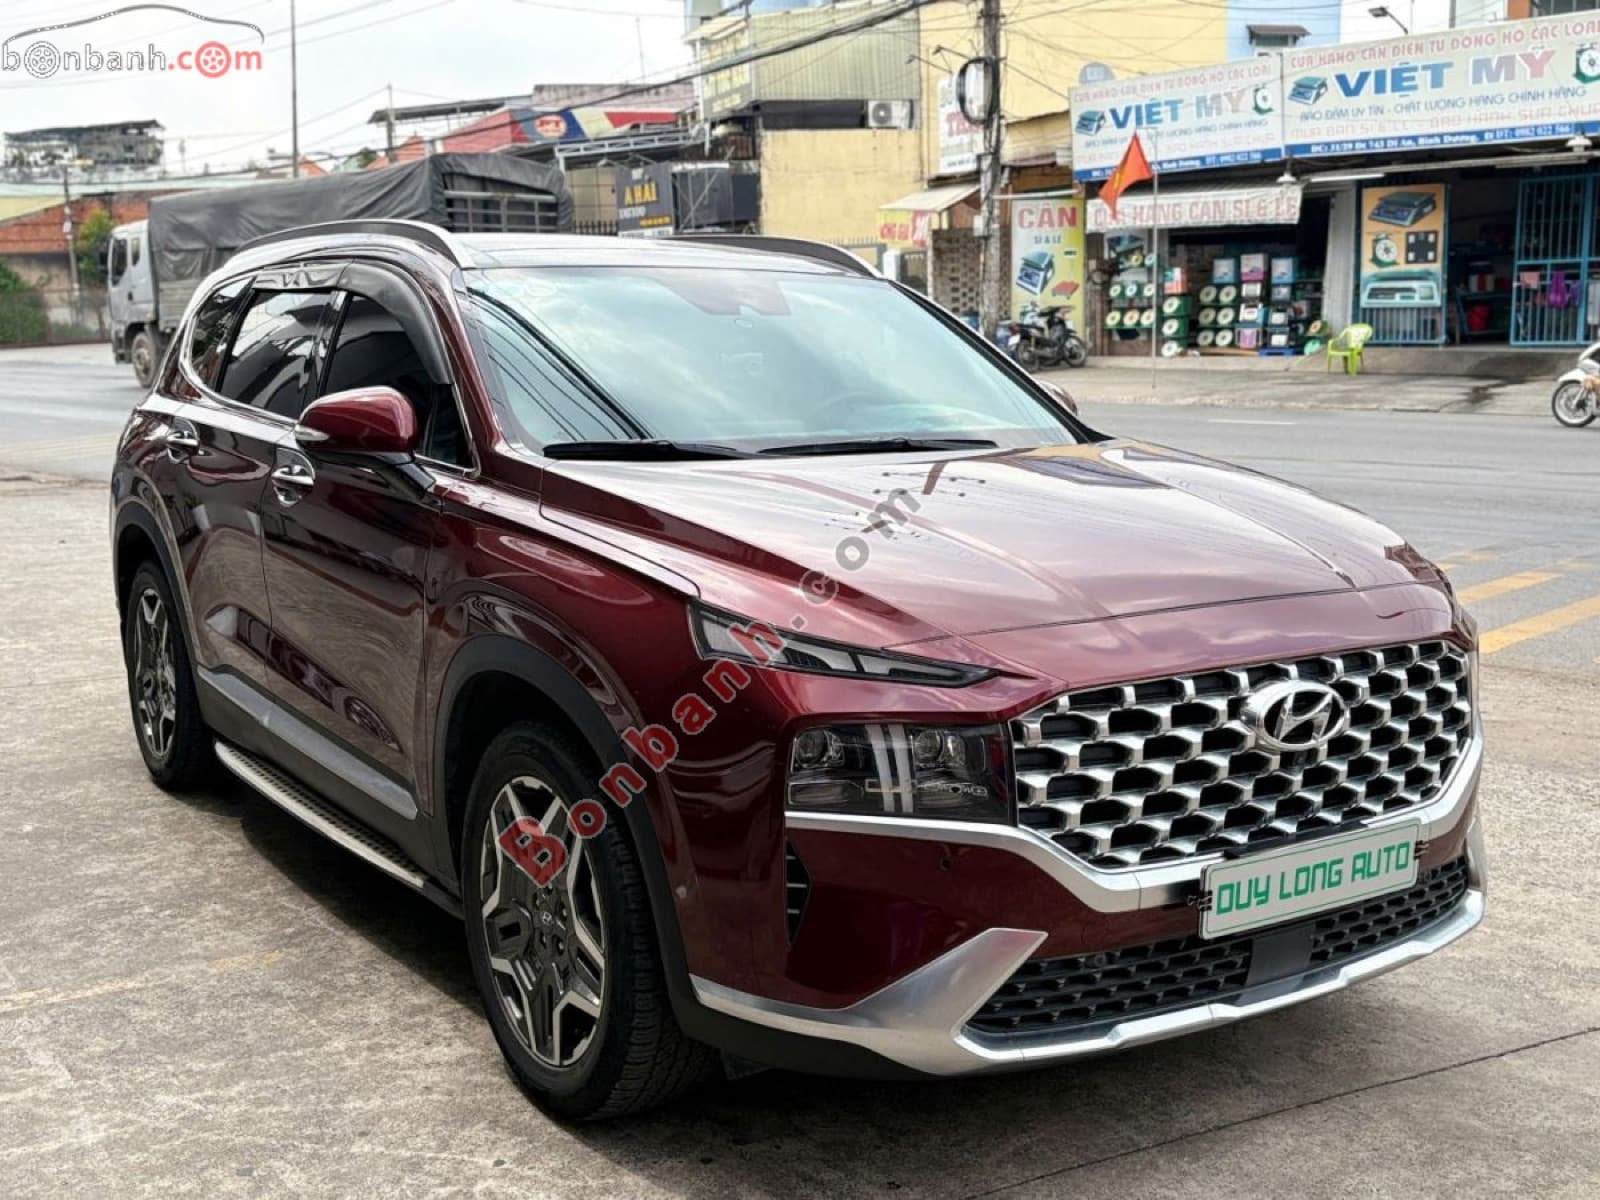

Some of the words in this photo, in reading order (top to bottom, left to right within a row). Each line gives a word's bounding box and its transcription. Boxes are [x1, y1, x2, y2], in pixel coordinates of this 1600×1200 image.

[1216, 875, 1270, 915] DUY
[1279, 857, 1344, 900] LONG
[1352, 841, 1410, 883] AUTO
